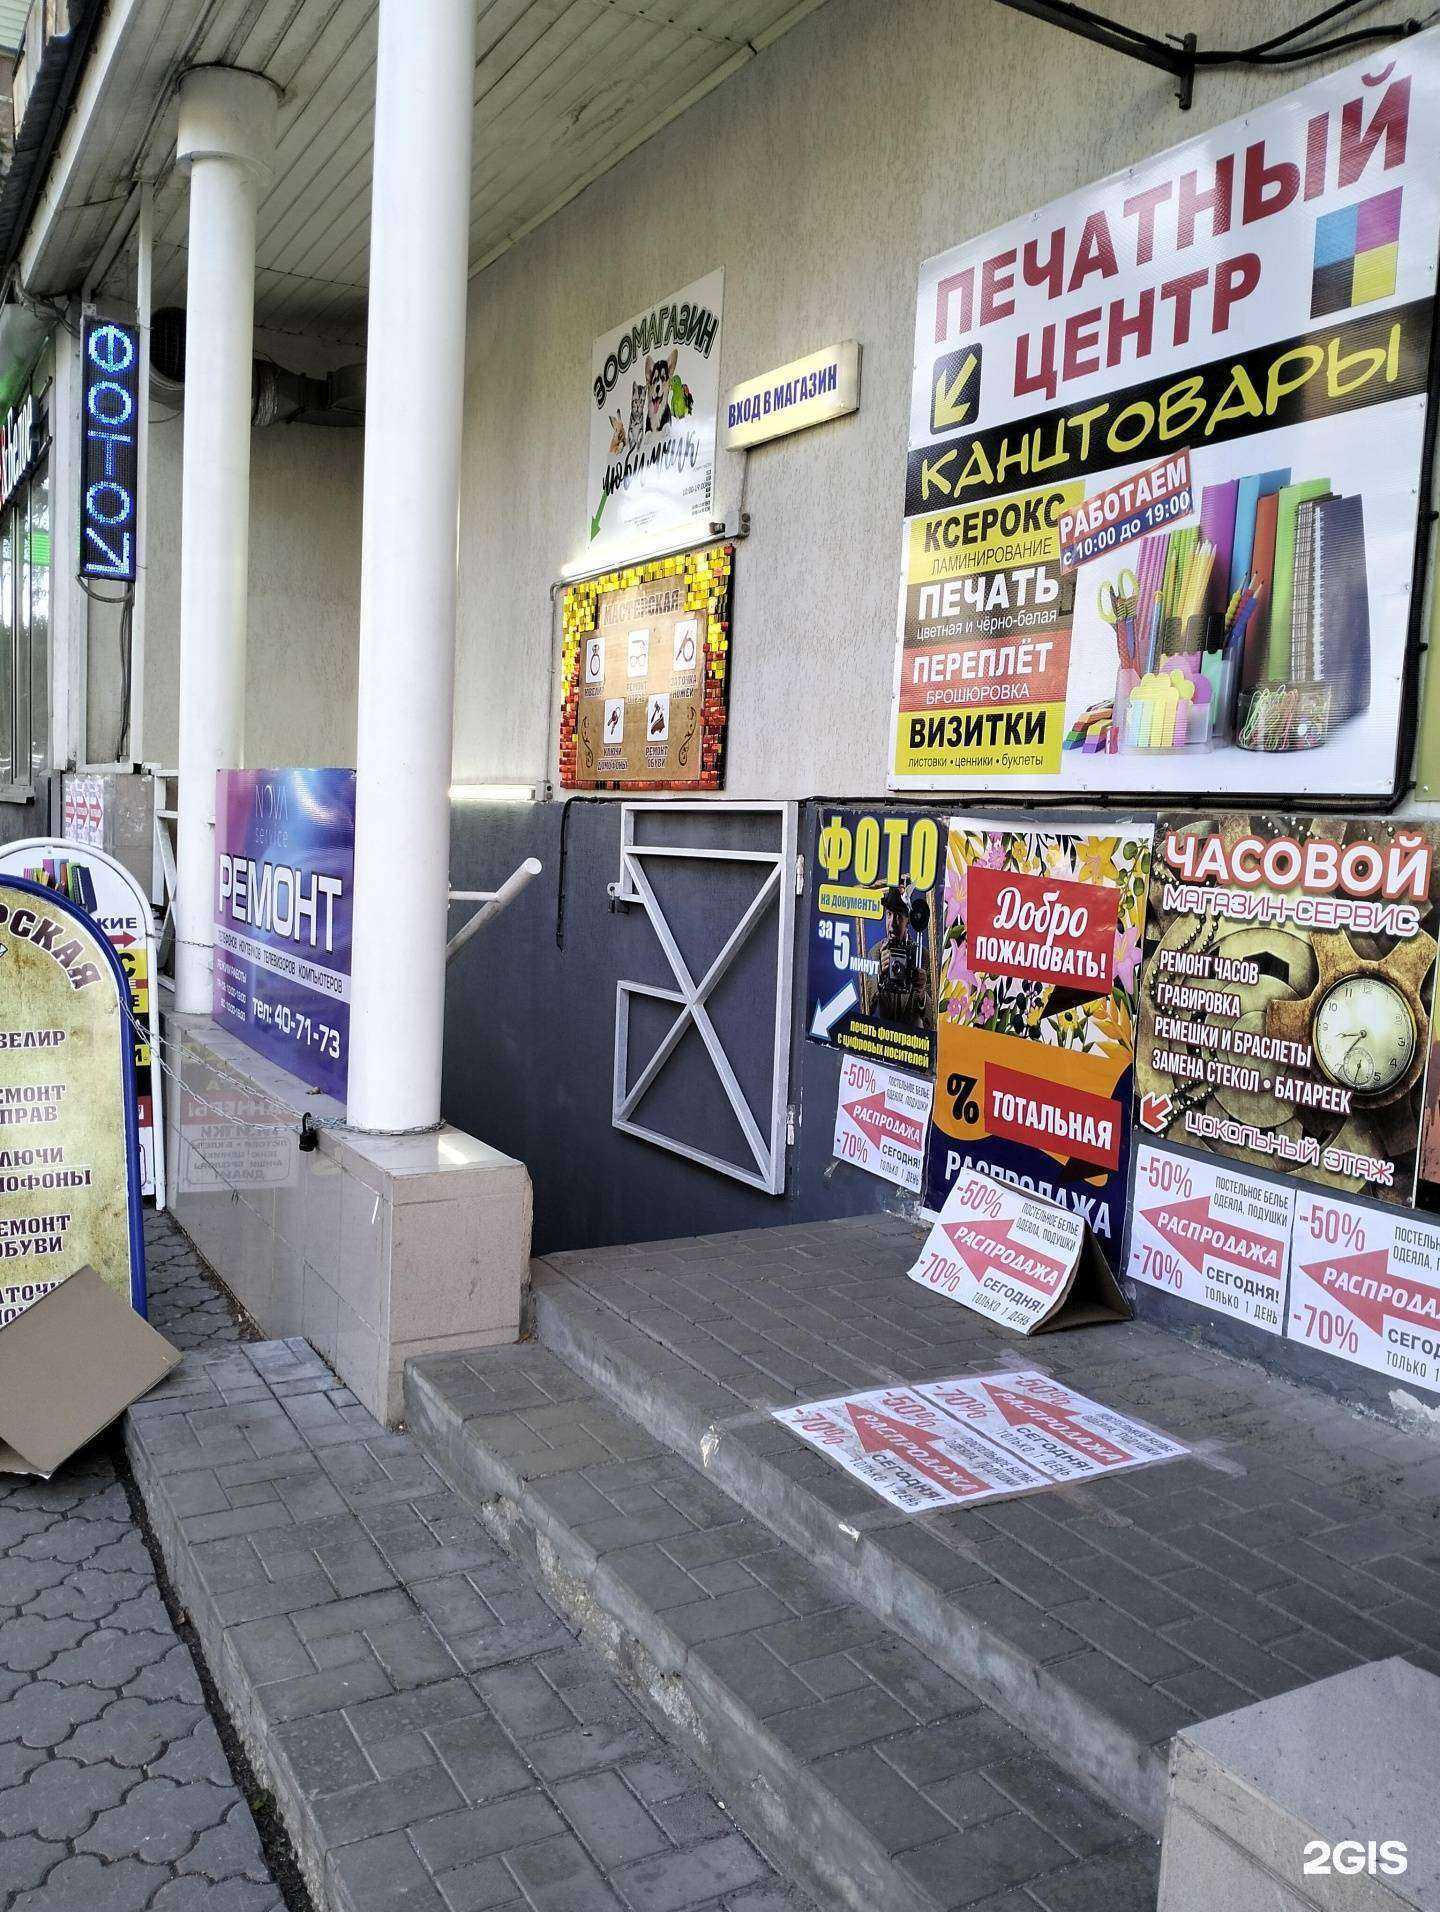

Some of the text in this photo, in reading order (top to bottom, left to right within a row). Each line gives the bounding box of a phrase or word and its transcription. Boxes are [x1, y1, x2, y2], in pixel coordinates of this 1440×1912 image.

[935, 61, 1412, 343] ПЕЧАТНЫЙ
[1014, 252, 1261, 400] ЦЕНТР
[594, 303, 720, 410] ЗООМАГАЗИН
[728, 363, 838, 428] ВХОД В МАГАЗИН
[921, 323, 1402, 500] КАНЦТОВАРЫ
[87, 325, 135, 525] ФОТО
[1060, 457, 1188, 544] РАБОТАЕМ
[924, 493, 1066, 554] КСЕРОКС
[1063, 489, 1189, 566] с 10:00 до 19:00
[931, 537, 1053, 575] ЛАМИНИРОВАНИЕ
[918, 566, 1060, 620] ПЕЧАТЬ
[917, 608, 1058, 641] цветная и чёрно-белая
[913, 637, 1053, 685] ПЕРЕПЛЁТ
[926, 684, 1030, 705] БРОШЮРОВКА
[909, 710, 1047, 750] ВИЗИТКИ
[907, 756, 948, 768] листовки
[1001, 753, 1044, 769] буклеты
[818, 816, 939, 892] ФОТО
[1166, 834, 1428, 897] ЧАСОВОЙ
[219, 853, 343, 955] РЕМОНТ
[820, 893, 880, 913] на документы
[992, 887, 1089, 946] Добро
[1163, 884, 1419, 936] МАГАЗИН-СЕРВИС
[818, 919, 880, 976] за 5 минут
[976, 935, 1107, 979] ПОЖАЛОВАТЬ!
[1160, 949, 1259, 985] РЕМОНТ ЧАСОВ
[298, 961, 343, 994] КОМПЬЮТЕРОВ
[1157, 983, 1241, 1018] ГРАВИРОВКА
[275, 1004, 340, 1059] 40-71-73
[837, 1033, 929, 1068] с цифровых носителей
[850, 1020, 930, 1052] печать фотографий
[1154, 1015, 1312, 1068] РЕМЕШКИ И БРАСЛЕТЫ
[0, 1085, 66, 1104] МОНТ
[843, 1063, 876, 1094] -50%
[1152, 1048, 1353, 1115] ЗАМЕНА СТЕКОЛ БАТАРЕЕК
[853, 1105, 920, 1143] РАСПРОДАЖА
[992, 1090, 1114, 1151] ТОТАЛЬНАЯ
[836, 1131, 868, 1164] -70%
[882, 1144, 920, 1170] СЕГОДНЯ!
[1184, 1111, 1395, 1187] ЦОКОЛЬНЫЙ ЭТАЖ
[1140, 1157, 1193, 1198] -50%
[1215, 1175, 1289, 1211] ПОСТЕЛЬНОЕ БЕЛЬЕ
[956, 1179, 1002, 1219] -50%
[1021, 1202, 1080, 1237] ПОСТЕЛЬНОЕ БЕЛЬЕ
[1213, 1192, 1288, 1228] ОДЕЯЛА, ПОДУШКИ
[1042, 1228, 1077, 1252] ПОДУШКИ
[1157, 1211, 1278, 1268] РАСПРОДАЖА
[1299, 1204, 1366, 1252] -50%
[920, 1252, 961, 1293] -70%
[954, 1226, 1060, 1287] РАСПРОДАЖА
[1133, 1244, 1183, 1290] -70%
[1393, 1245, 1433, 1271] ОДЕЯЛА,
[983, 1276, 1045, 1314] СЕГОДНЯ!
[1205, 1286, 1278, 1325] ТОЛЬКО 1 ДЕНЬ
[1206, 1266, 1280, 1304] СЕГОДНЯ!
[1323, 1267, 1440, 1320] РАСПРОДА
[972, 1292, 1001, 1313] ТОЛЬКО
[1008, 1310, 1031, 1327] ДЕНЬ
[1293, 1303, 1358, 1354] -70%
[1386, 1350, 1427, 1378] ТОЛЬКО
[880, 1391, 944, 1428] -50%
[934, 1385, 994, 1420] -70%
[1016, 1375, 1077, 1407] -50%
[791, 1409, 853, 1445] -70%
[994, 1392, 1124, 1462] РАСПРОДАЖА
[856, 1413, 979, 1492] РАСПРОДАЖА
[1017, 1427, 1094, 1472] СЕГОДНЯ!
[871, 1453, 946, 1502] СЕГОДНЯ!
